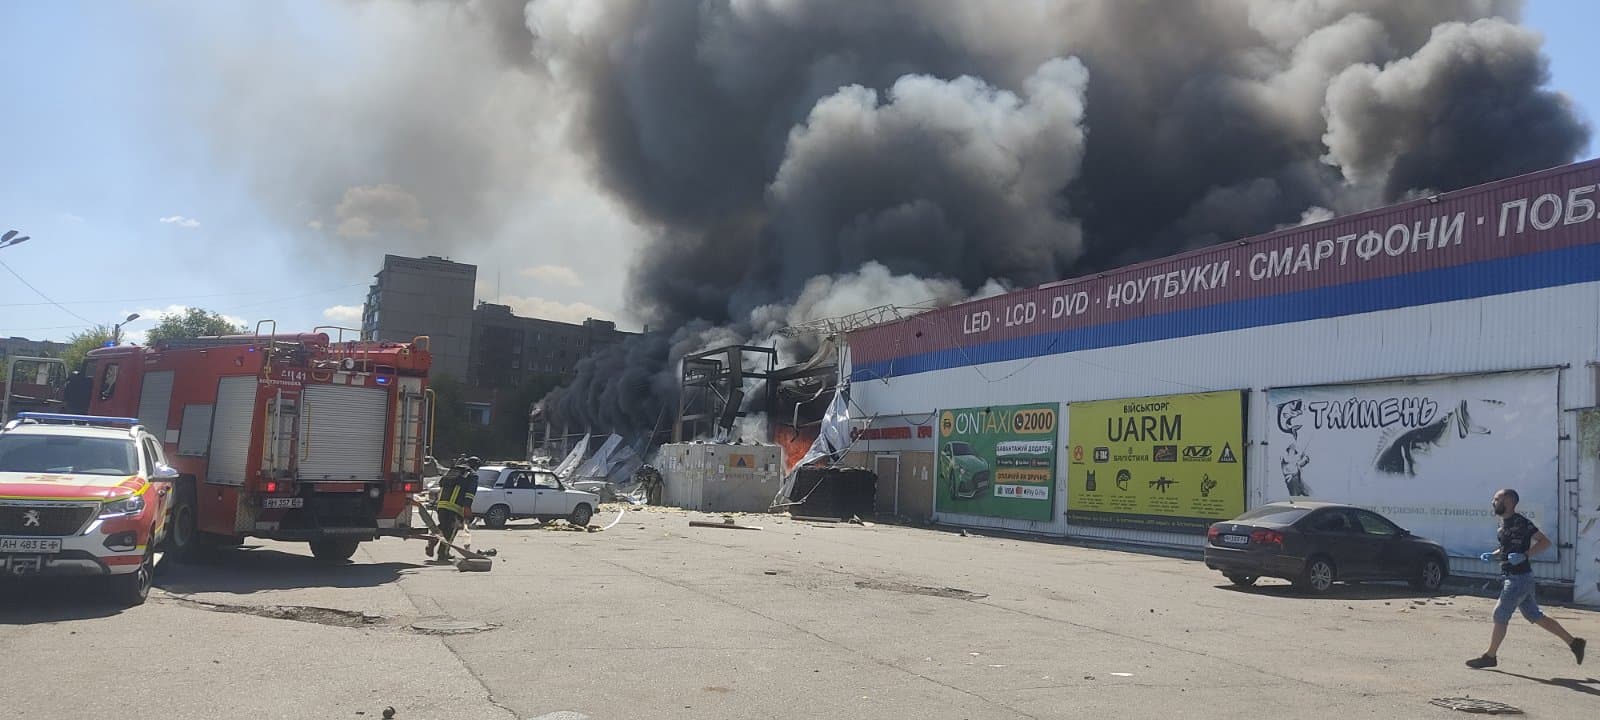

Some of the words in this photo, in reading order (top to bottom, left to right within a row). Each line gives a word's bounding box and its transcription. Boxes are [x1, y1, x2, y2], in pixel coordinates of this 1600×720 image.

[963, 310, 991, 335] LED
[1005, 302, 1036, 327] LCD
[1052, 291, 1088, 319] DVD
[1106, 260, 1230, 309] НОУТБУКИ
[1249, 211, 1465, 281] СМАРТФОНИ
[1123, 402, 1170, 414] ВІЙСЬКТОРГ
[1308, 396, 1439, 430] ТАЙМЕНЬ
[1024, 411, 1053, 431] 2000
[1108, 414, 1182, 442] UARM
[2, 540, 17, 549] AH
[20, 540, 37, 549] 483
